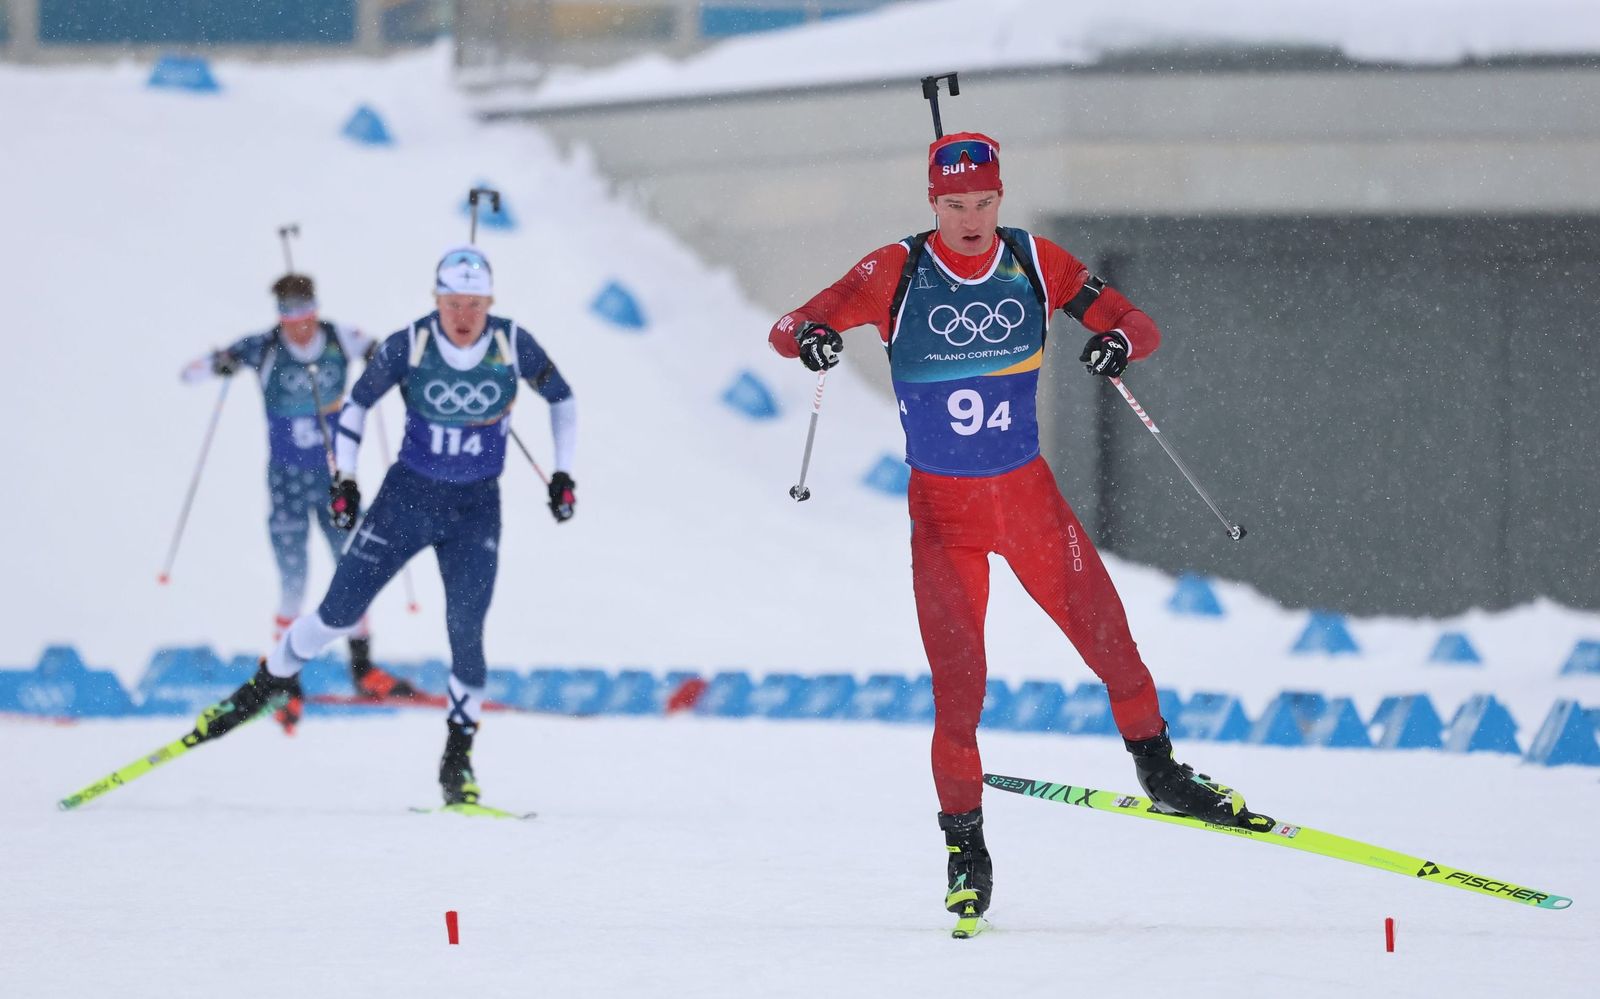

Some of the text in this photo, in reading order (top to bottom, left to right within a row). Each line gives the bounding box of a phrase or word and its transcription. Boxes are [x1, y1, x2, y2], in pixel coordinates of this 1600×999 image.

[942, 162, 965, 176] SUI
[924, 343, 1030, 362] MILANO CORTINA 2026
[1067, 524, 1083, 572] odlo
[988, 775, 1025, 789] SPEED
[1024, 780, 1098, 809] MAX
[1444, 871, 1549, 905] FISCHER
